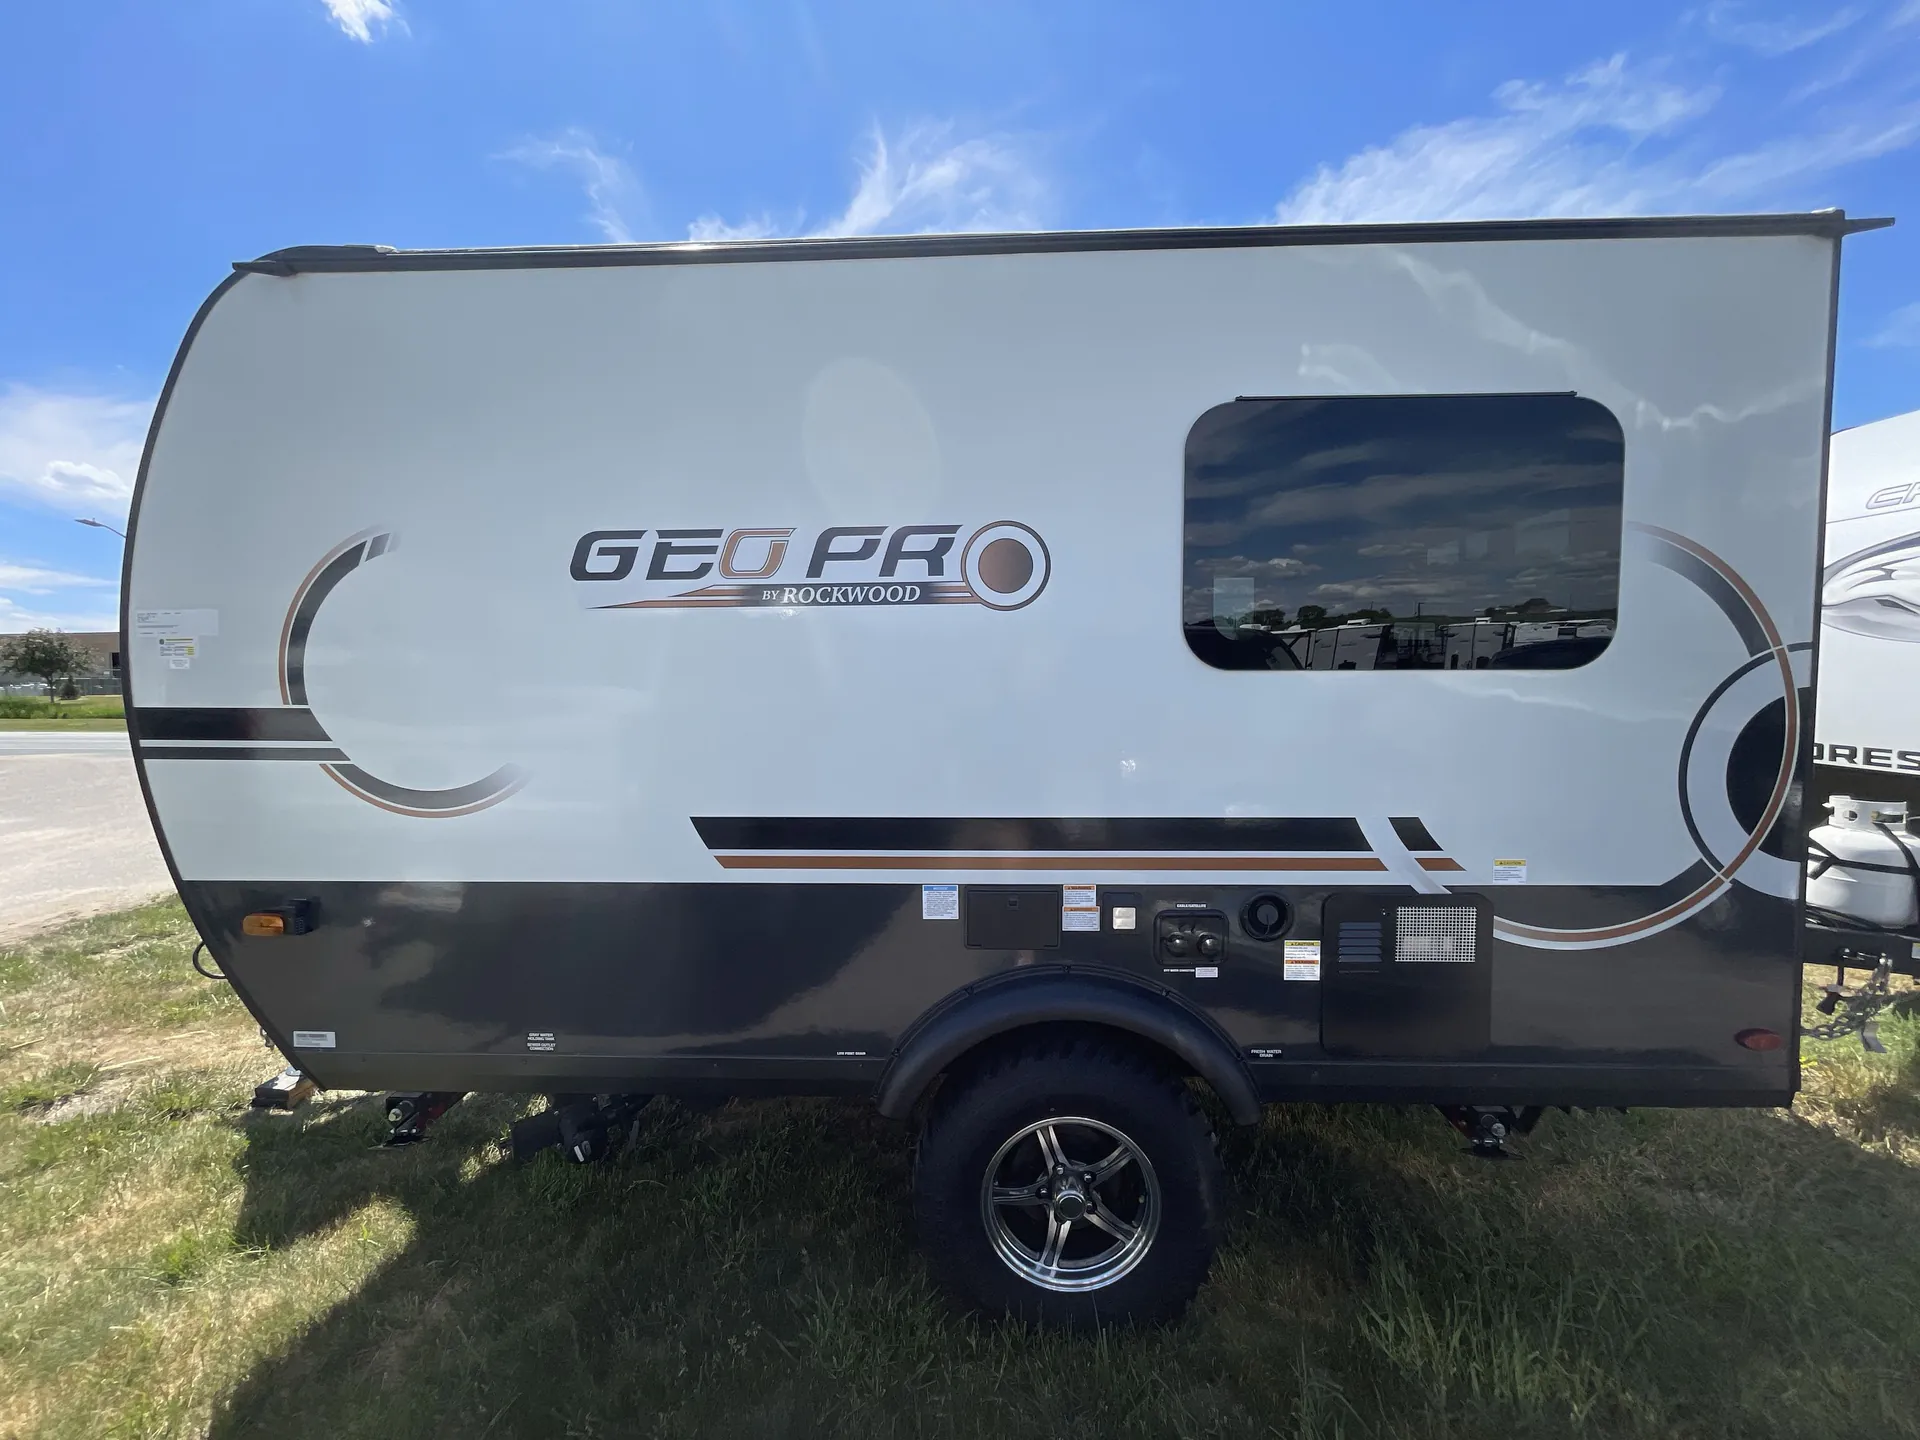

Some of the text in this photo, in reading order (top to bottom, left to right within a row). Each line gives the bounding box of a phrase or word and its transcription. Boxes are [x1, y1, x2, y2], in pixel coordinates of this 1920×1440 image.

[569, 527, 797, 581] GEO
[762, 585, 921, 604] BY ROCKWOOD
